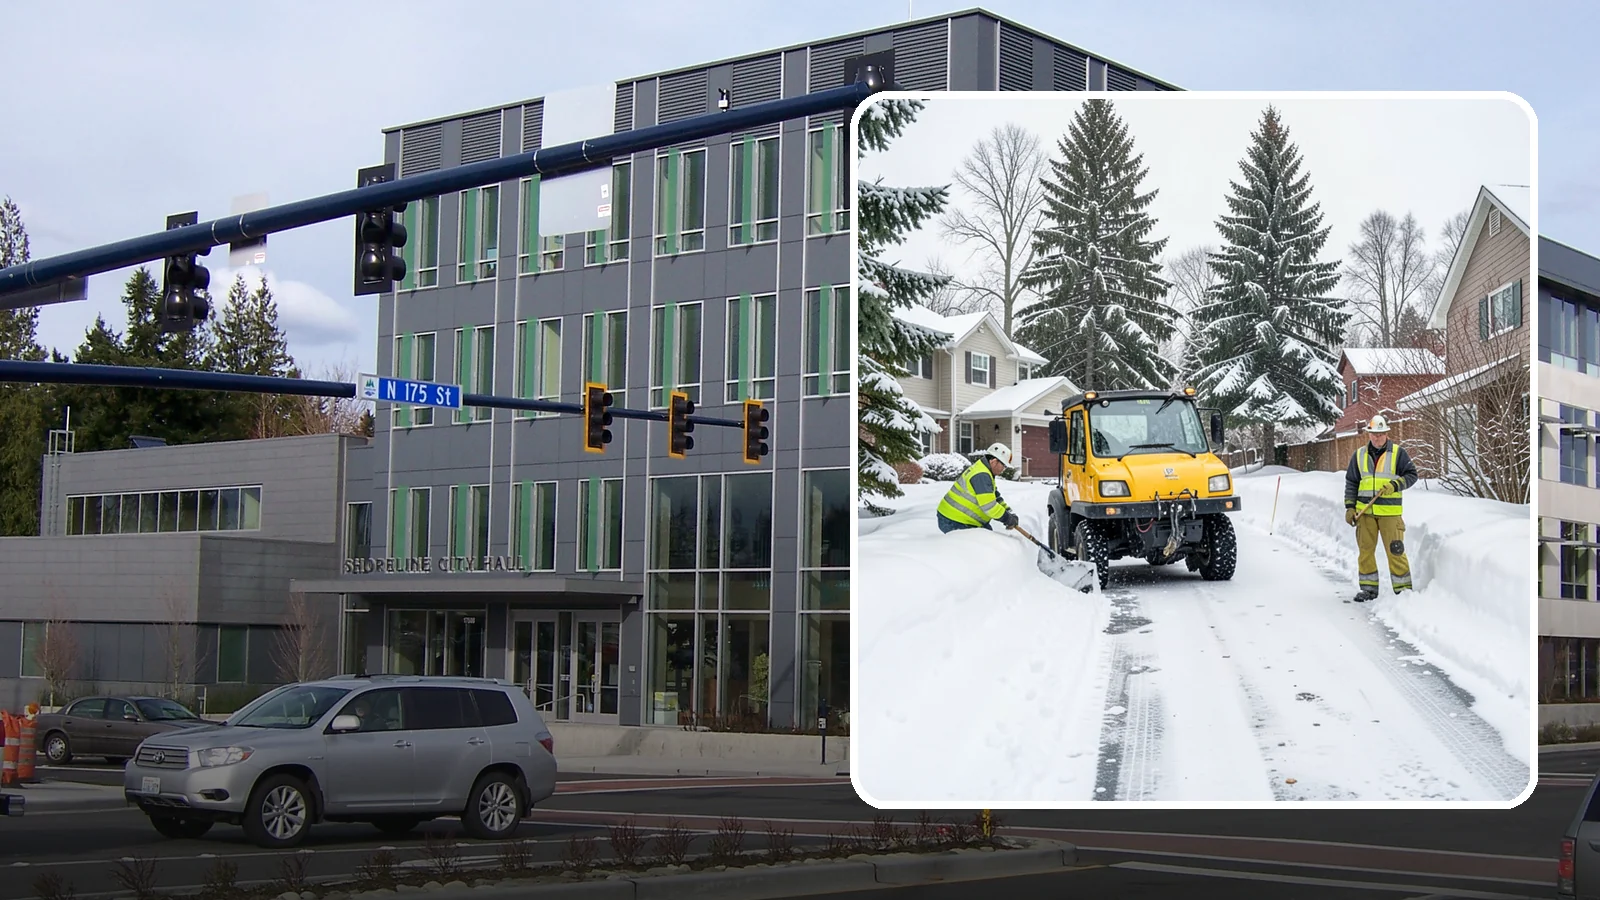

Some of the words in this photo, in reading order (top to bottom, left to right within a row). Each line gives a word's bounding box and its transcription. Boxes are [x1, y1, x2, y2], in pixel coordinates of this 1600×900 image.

[387, 380, 396, 400] N
[405, 382, 427, 403] 175
[436, 386, 451, 406] St
[344, 556, 431, 574] SHORELINE
[438, 556, 475, 573] CITY
[484, 555, 525, 572] HALL
